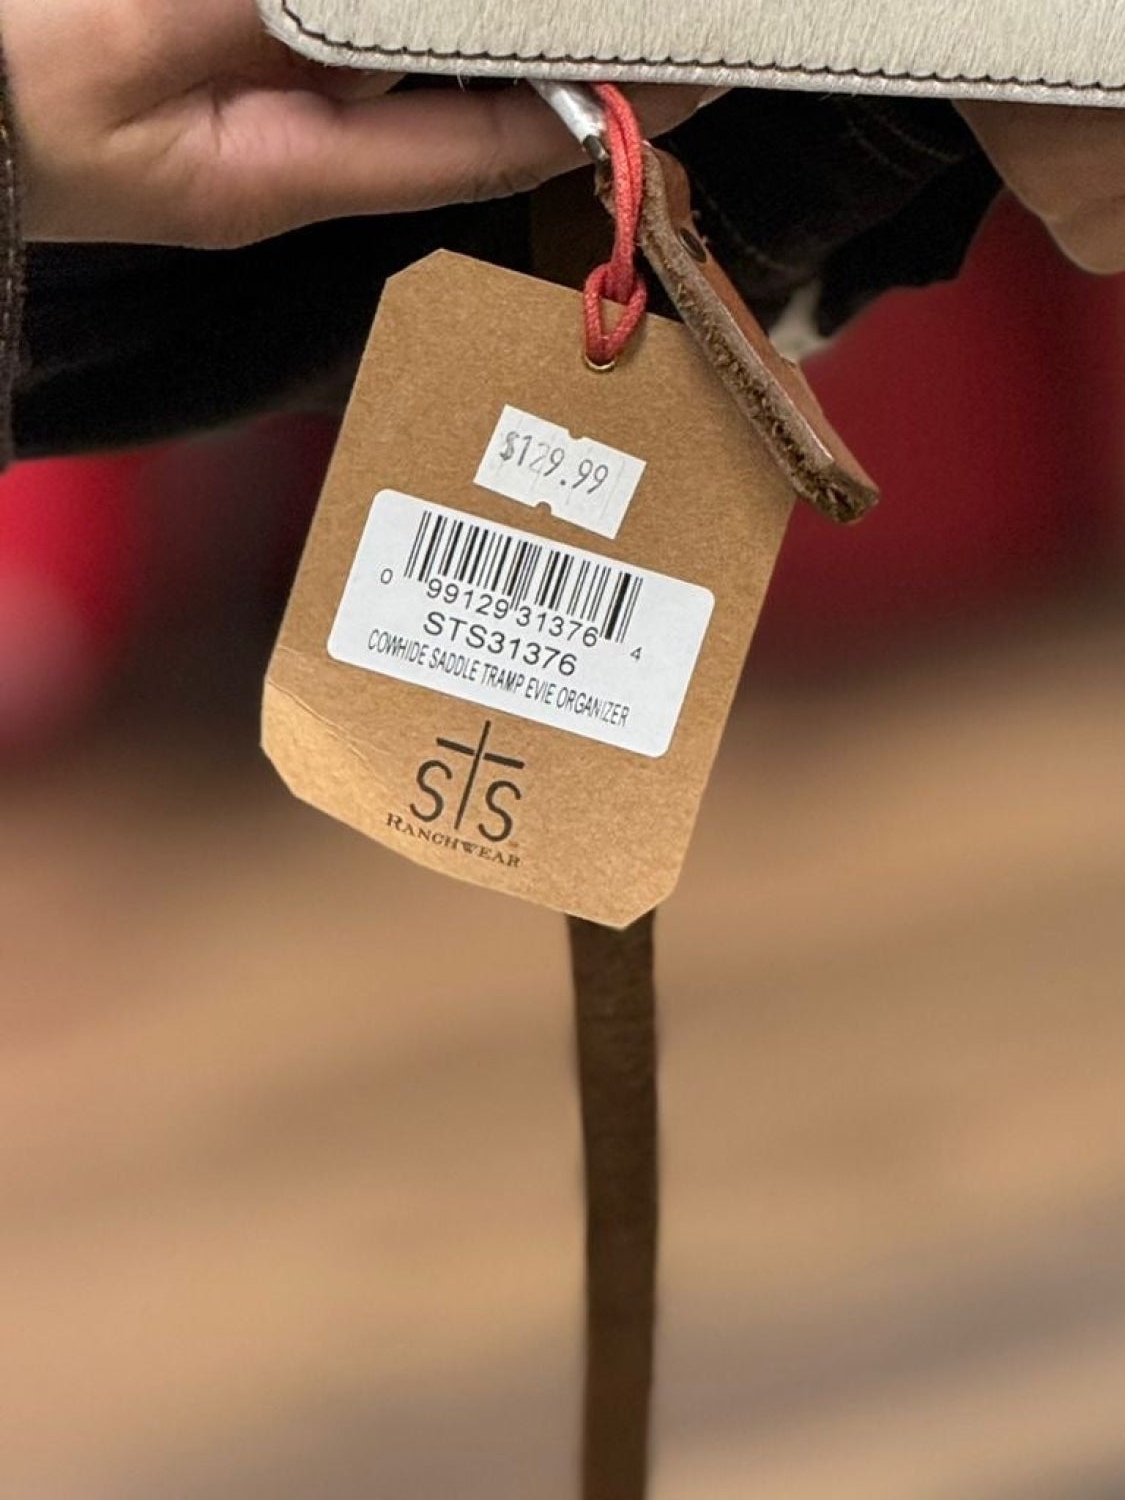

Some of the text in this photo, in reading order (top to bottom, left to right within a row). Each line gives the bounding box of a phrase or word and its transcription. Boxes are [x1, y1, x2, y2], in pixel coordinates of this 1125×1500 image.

[499, 431, 609, 494] $129.99
[380, 568, 643, 662] 0 99129 31376 4
[423, 611, 579, 677] STS31376
[368, 628, 631, 728] COWHIDE SADDLE TRAMP EVIE ORGANIZER
[409, 719, 526, 842] STS
[386, 812, 522, 868] RANCHWEAR
